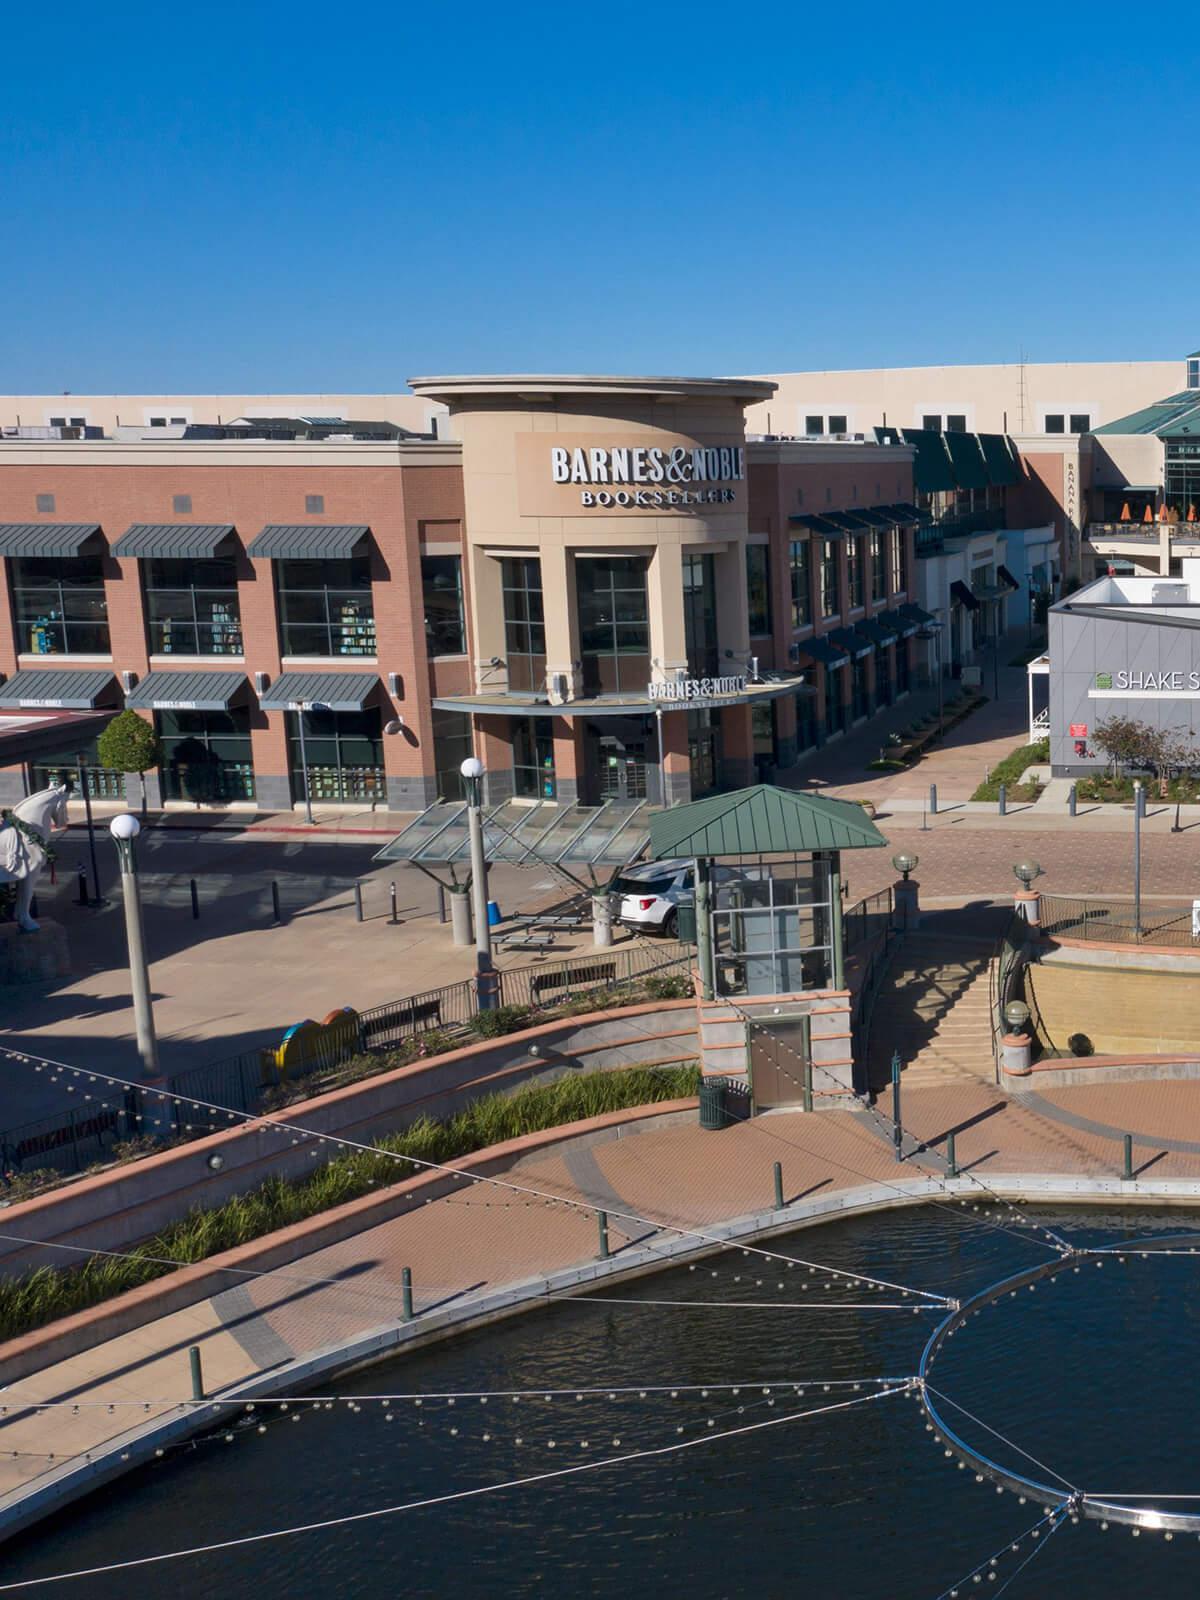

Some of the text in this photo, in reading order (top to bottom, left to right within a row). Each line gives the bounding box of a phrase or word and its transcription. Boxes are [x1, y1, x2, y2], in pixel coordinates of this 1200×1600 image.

[1067, 463, 1075, 504] BANANA
[581, 488, 736, 506] BOOKSELLERS
[1117, 671, 1184, 690] SHAKE
